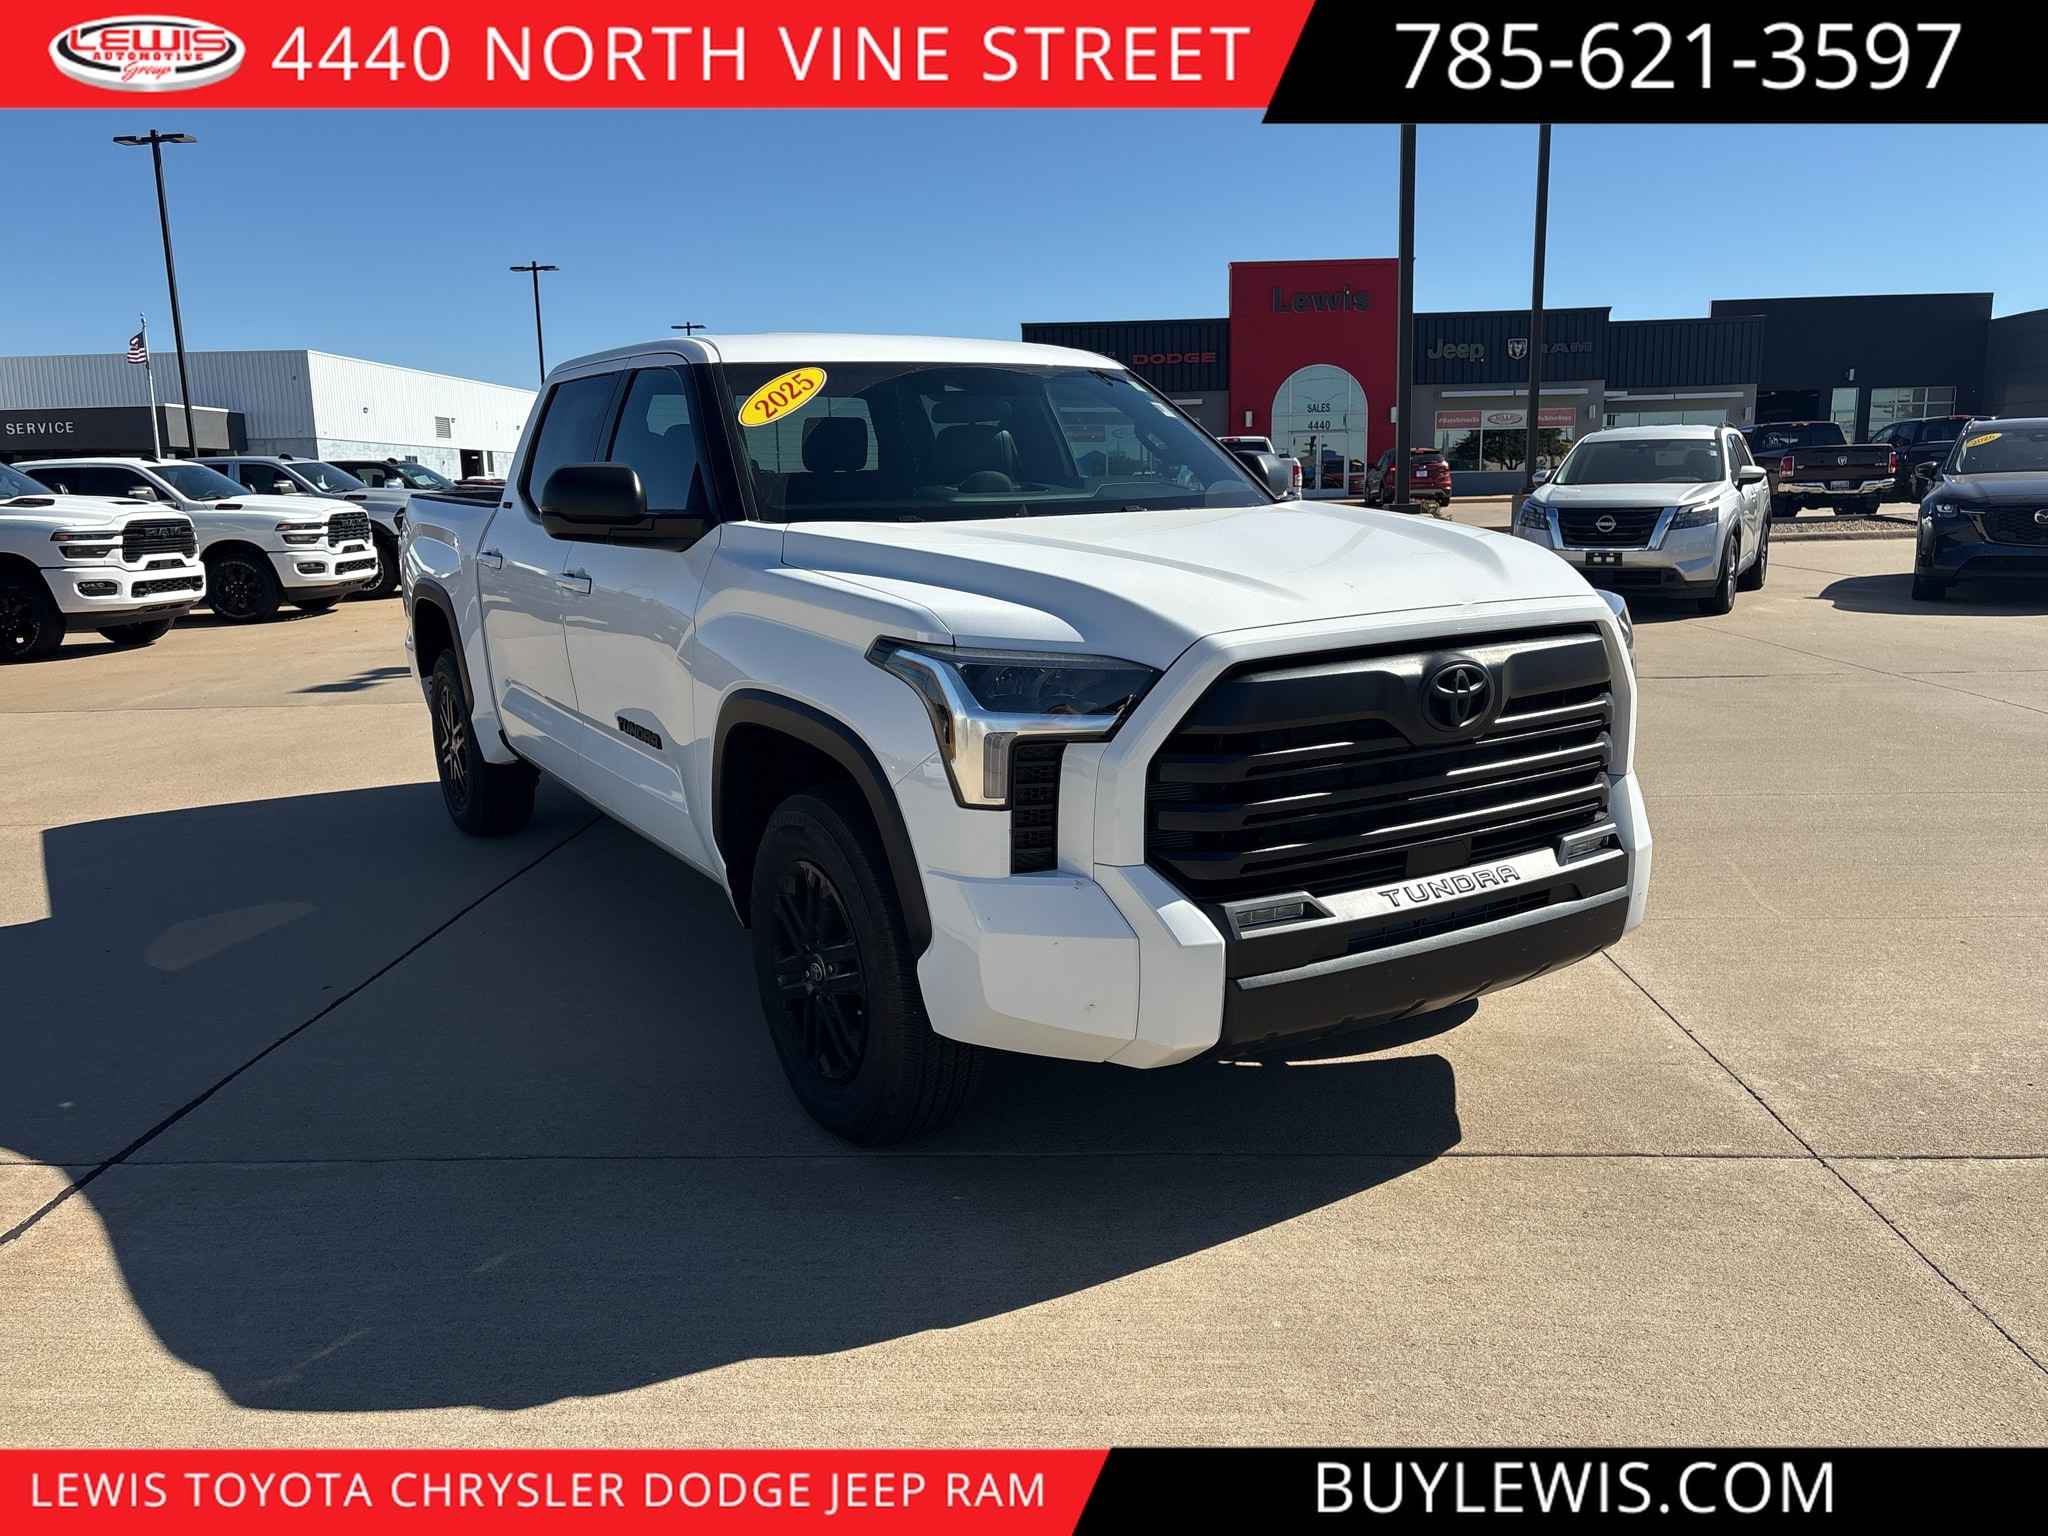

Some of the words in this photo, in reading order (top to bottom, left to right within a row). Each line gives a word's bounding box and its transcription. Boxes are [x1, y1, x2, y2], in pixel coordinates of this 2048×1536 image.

[1272, 285, 1371, 314] Lewis
[1133, 352, 1216, 365] DODGE
[1427, 338, 1485, 362] Jeep
[754, 373, 814, 419] 2025
[1307, 403, 1331, 413] SALES
[5, 422, 75, 435] SERVICE
[1308, 420, 1331, 430] 4440
[143, 526, 183, 537] RAM
[617, 716, 663, 750] TUNDRA
[1377, 864, 1521, 907] TUNDRA
